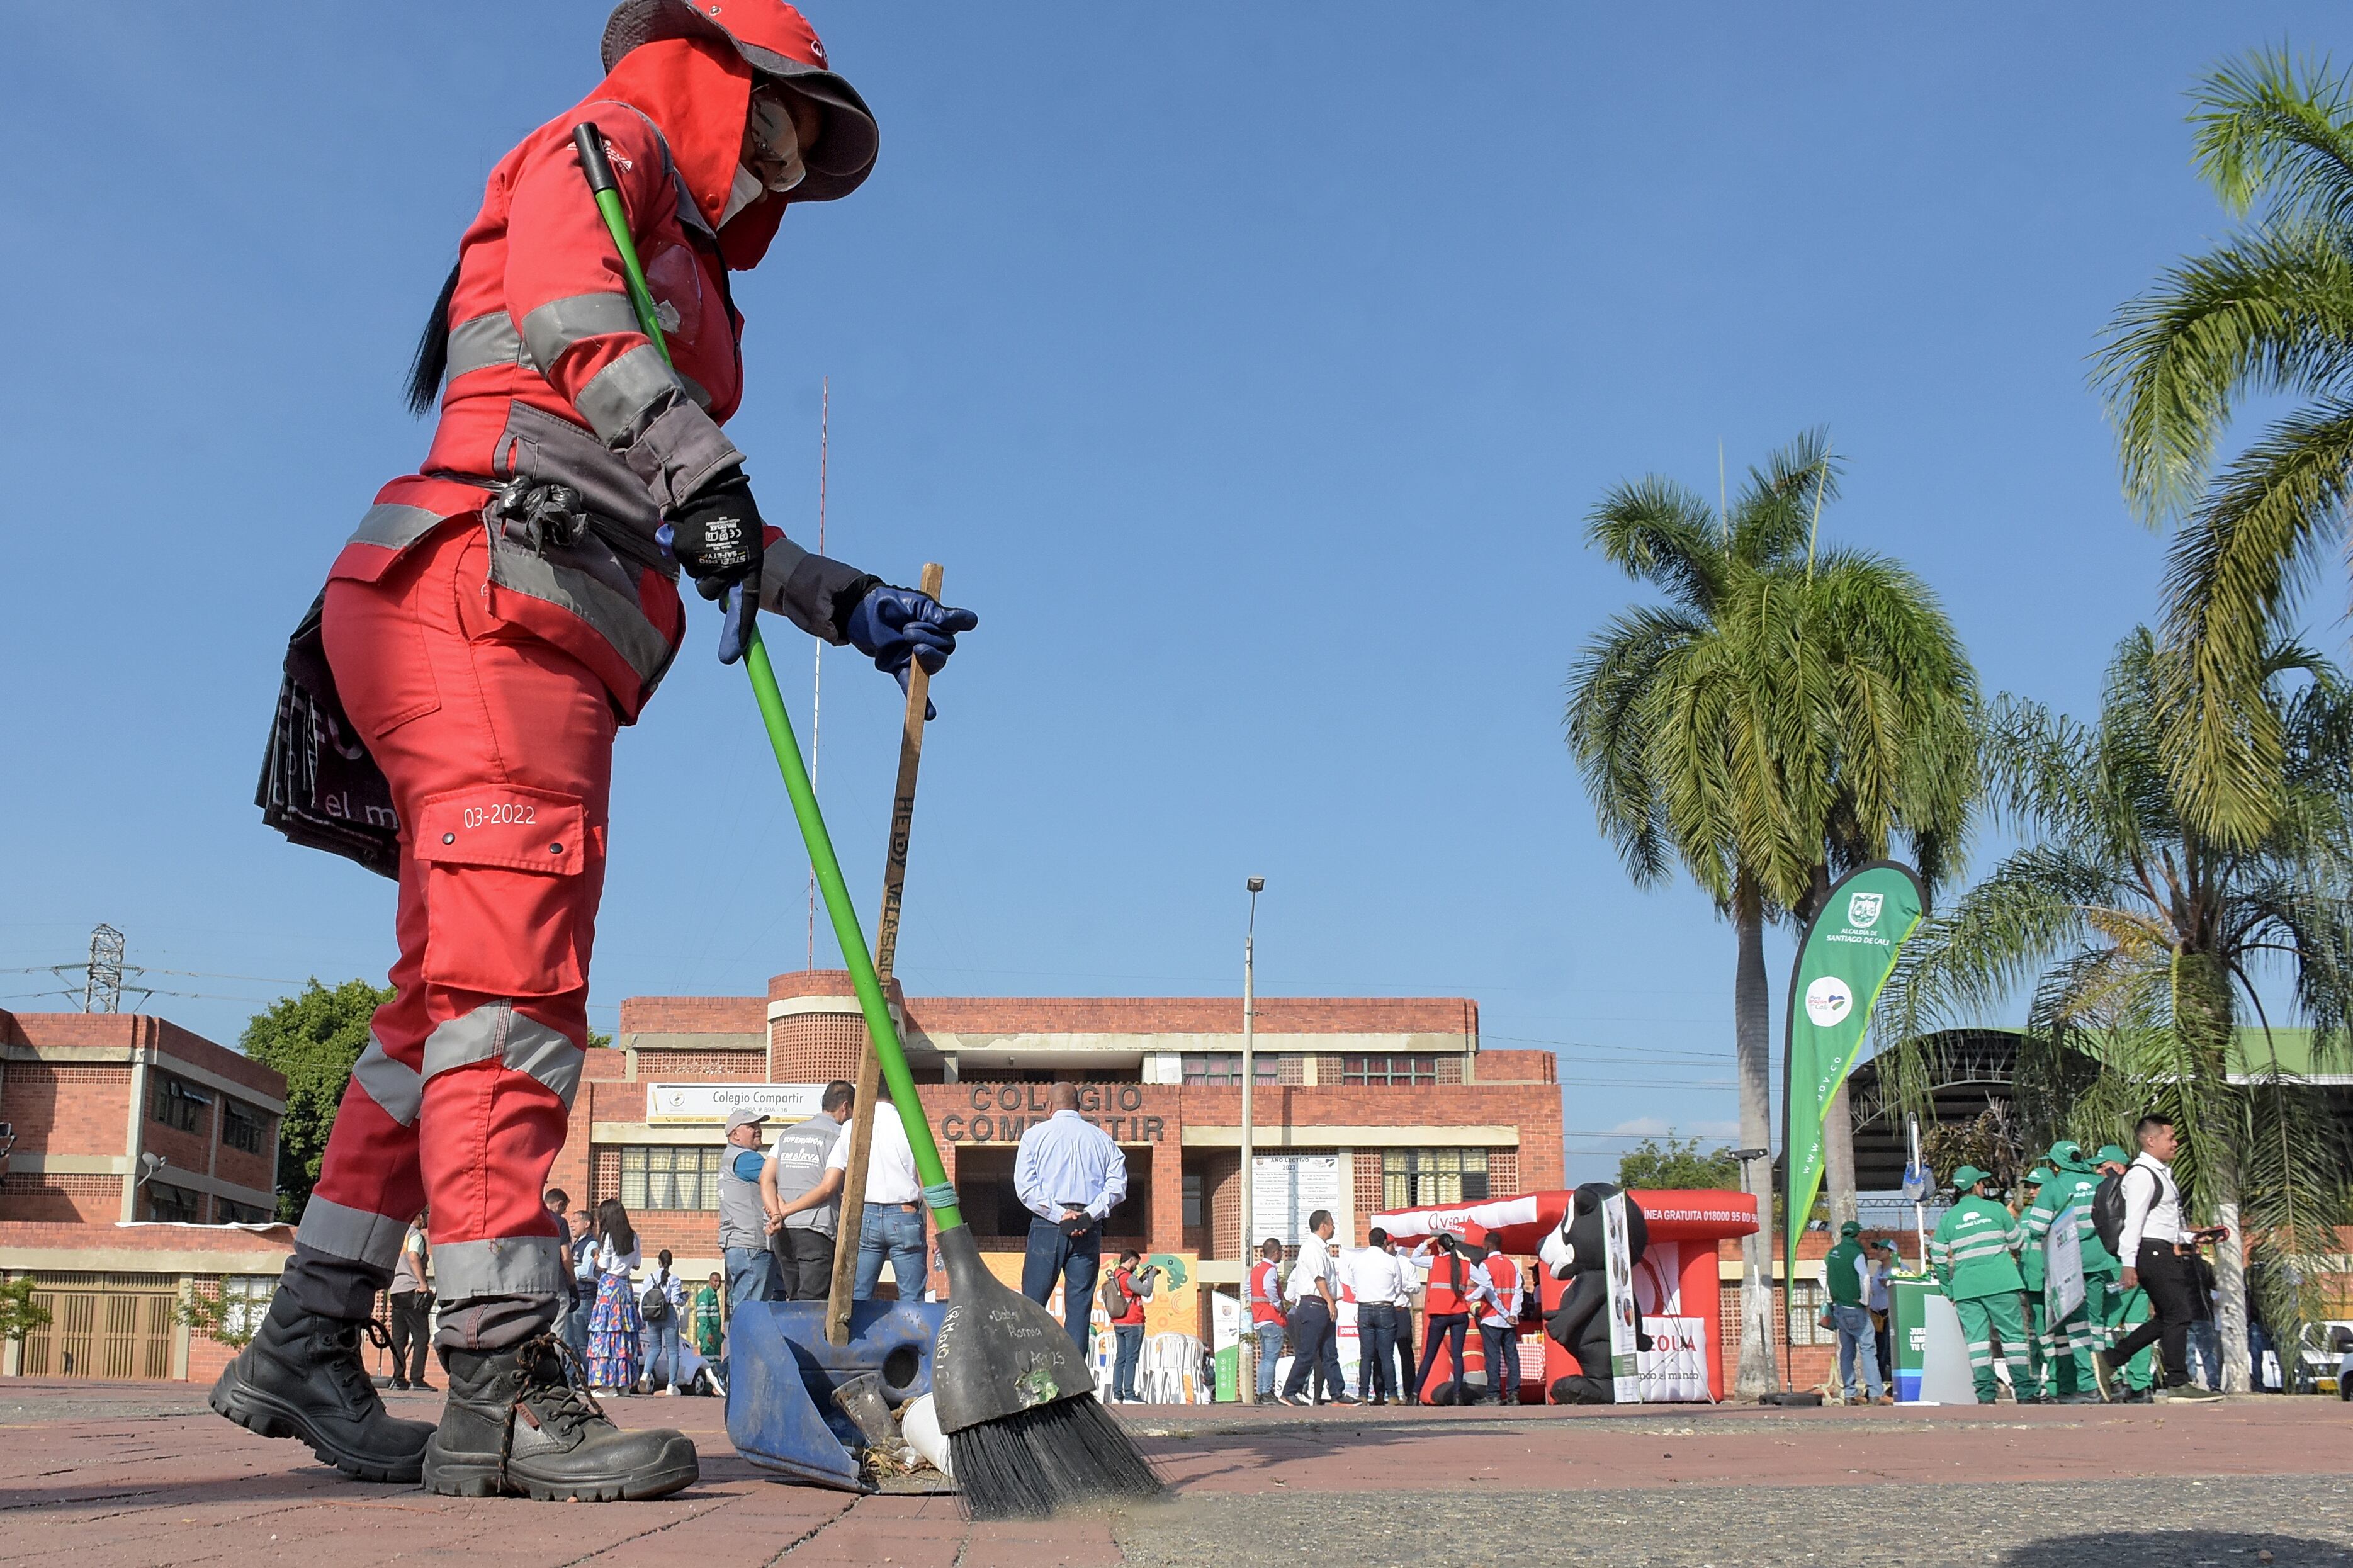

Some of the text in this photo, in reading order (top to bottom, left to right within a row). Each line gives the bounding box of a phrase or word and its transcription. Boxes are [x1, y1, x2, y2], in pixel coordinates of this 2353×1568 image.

[708, 551, 737, 560] SAFETY
[464, 803, 536, 828] 03-2022
[1826, 935, 1863, 943] SANTIAGO
[1874, 938, 1890, 946] CALI
[713, 1091, 804, 1105] Colegio Compartir
[970, 1084, 1143, 1112] COLGIO
[940, 1114, 1165, 1142] COMTIR
[1644, 1207, 1663, 1220] ÍNEA
[1664, 1210, 1703, 1221] GRATUITA
[1703, 1210, 1730, 1222] 018000
[1731, 1211, 1741, 1222] 95
[1742, 1213, 1751, 1223] 00
[1668, 1370, 1699, 1380] mundo
